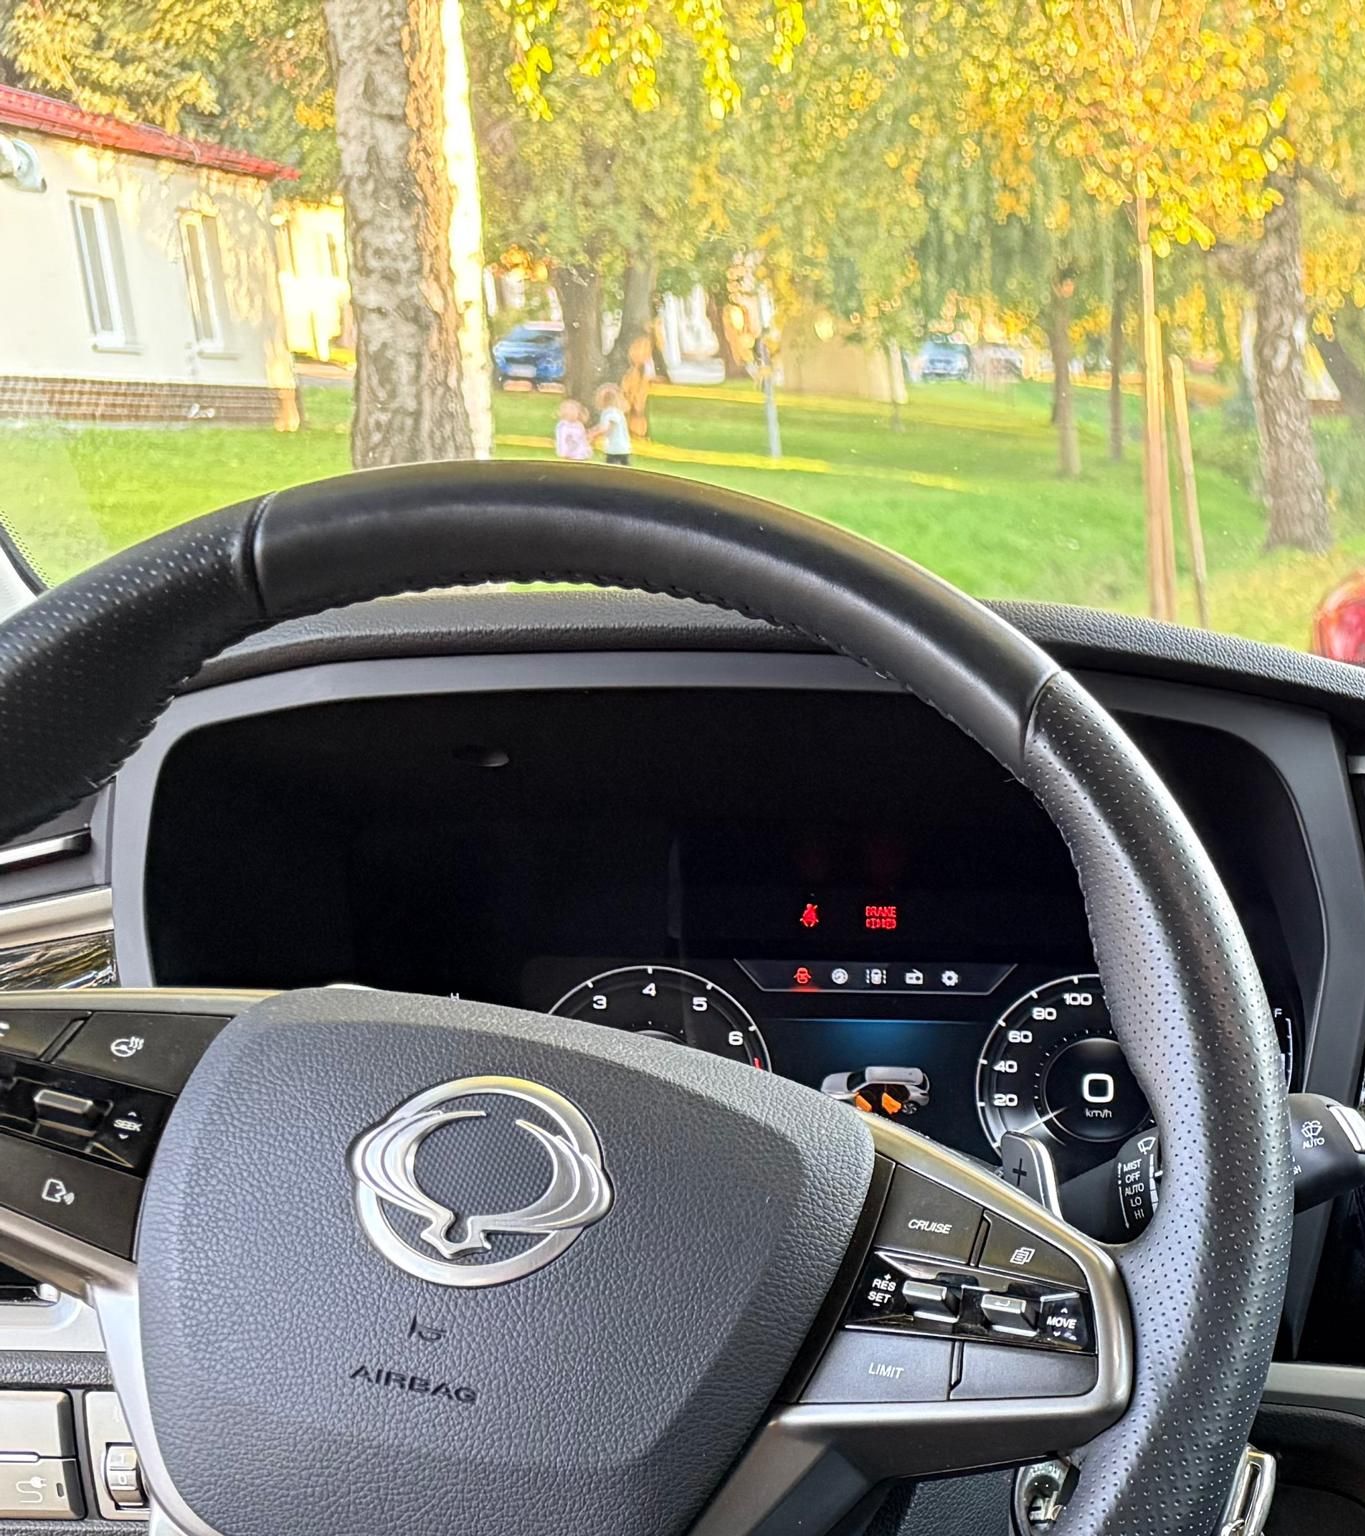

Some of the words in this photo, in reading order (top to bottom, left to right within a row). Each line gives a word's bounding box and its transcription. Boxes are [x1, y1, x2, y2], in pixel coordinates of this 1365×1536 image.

[642, 982, 656, 996] 4
[592, 995, 607, 1009] 3
[692, 996, 708, 1011] 5
[1062, 993, 1092, 1006] 100
[1032, 1007, 1056, 1020] 80
[1273, 1007, 1283, 1018] F
[728, 1031, 744, 1045] 6
[1008, 1030, 1032, 1043] 60
[992, 1060, 1017, 1073] 40
[1082, 1072, 1114, 1103] 0
[993, 1093, 1017, 1106] 20
[1084, 1108, 1112, 1119] km/h
[113, 1118, 142, 1132] SEEK
[1301, 1137, 1325, 1150] AUTO
[1122, 1159, 1142, 1172] MIST
[1124, 1171, 1142, 1183] OFF
[1124, 1184, 1144, 1197] AUTO
[1129, 1196, 1143, 1208] LO
[1134, 1208, 1145, 1219] HI
[907, 1218, 952, 1234] CRUISE
[871, 1277, 896, 1291] RES
[867, 1290, 891, 1304] SET
[1046, 1315, 1077, 1329] MOVE
[867, 1362, 904, 1379] LIMIT
[350, 1364, 477, 1403] AIRBAG
